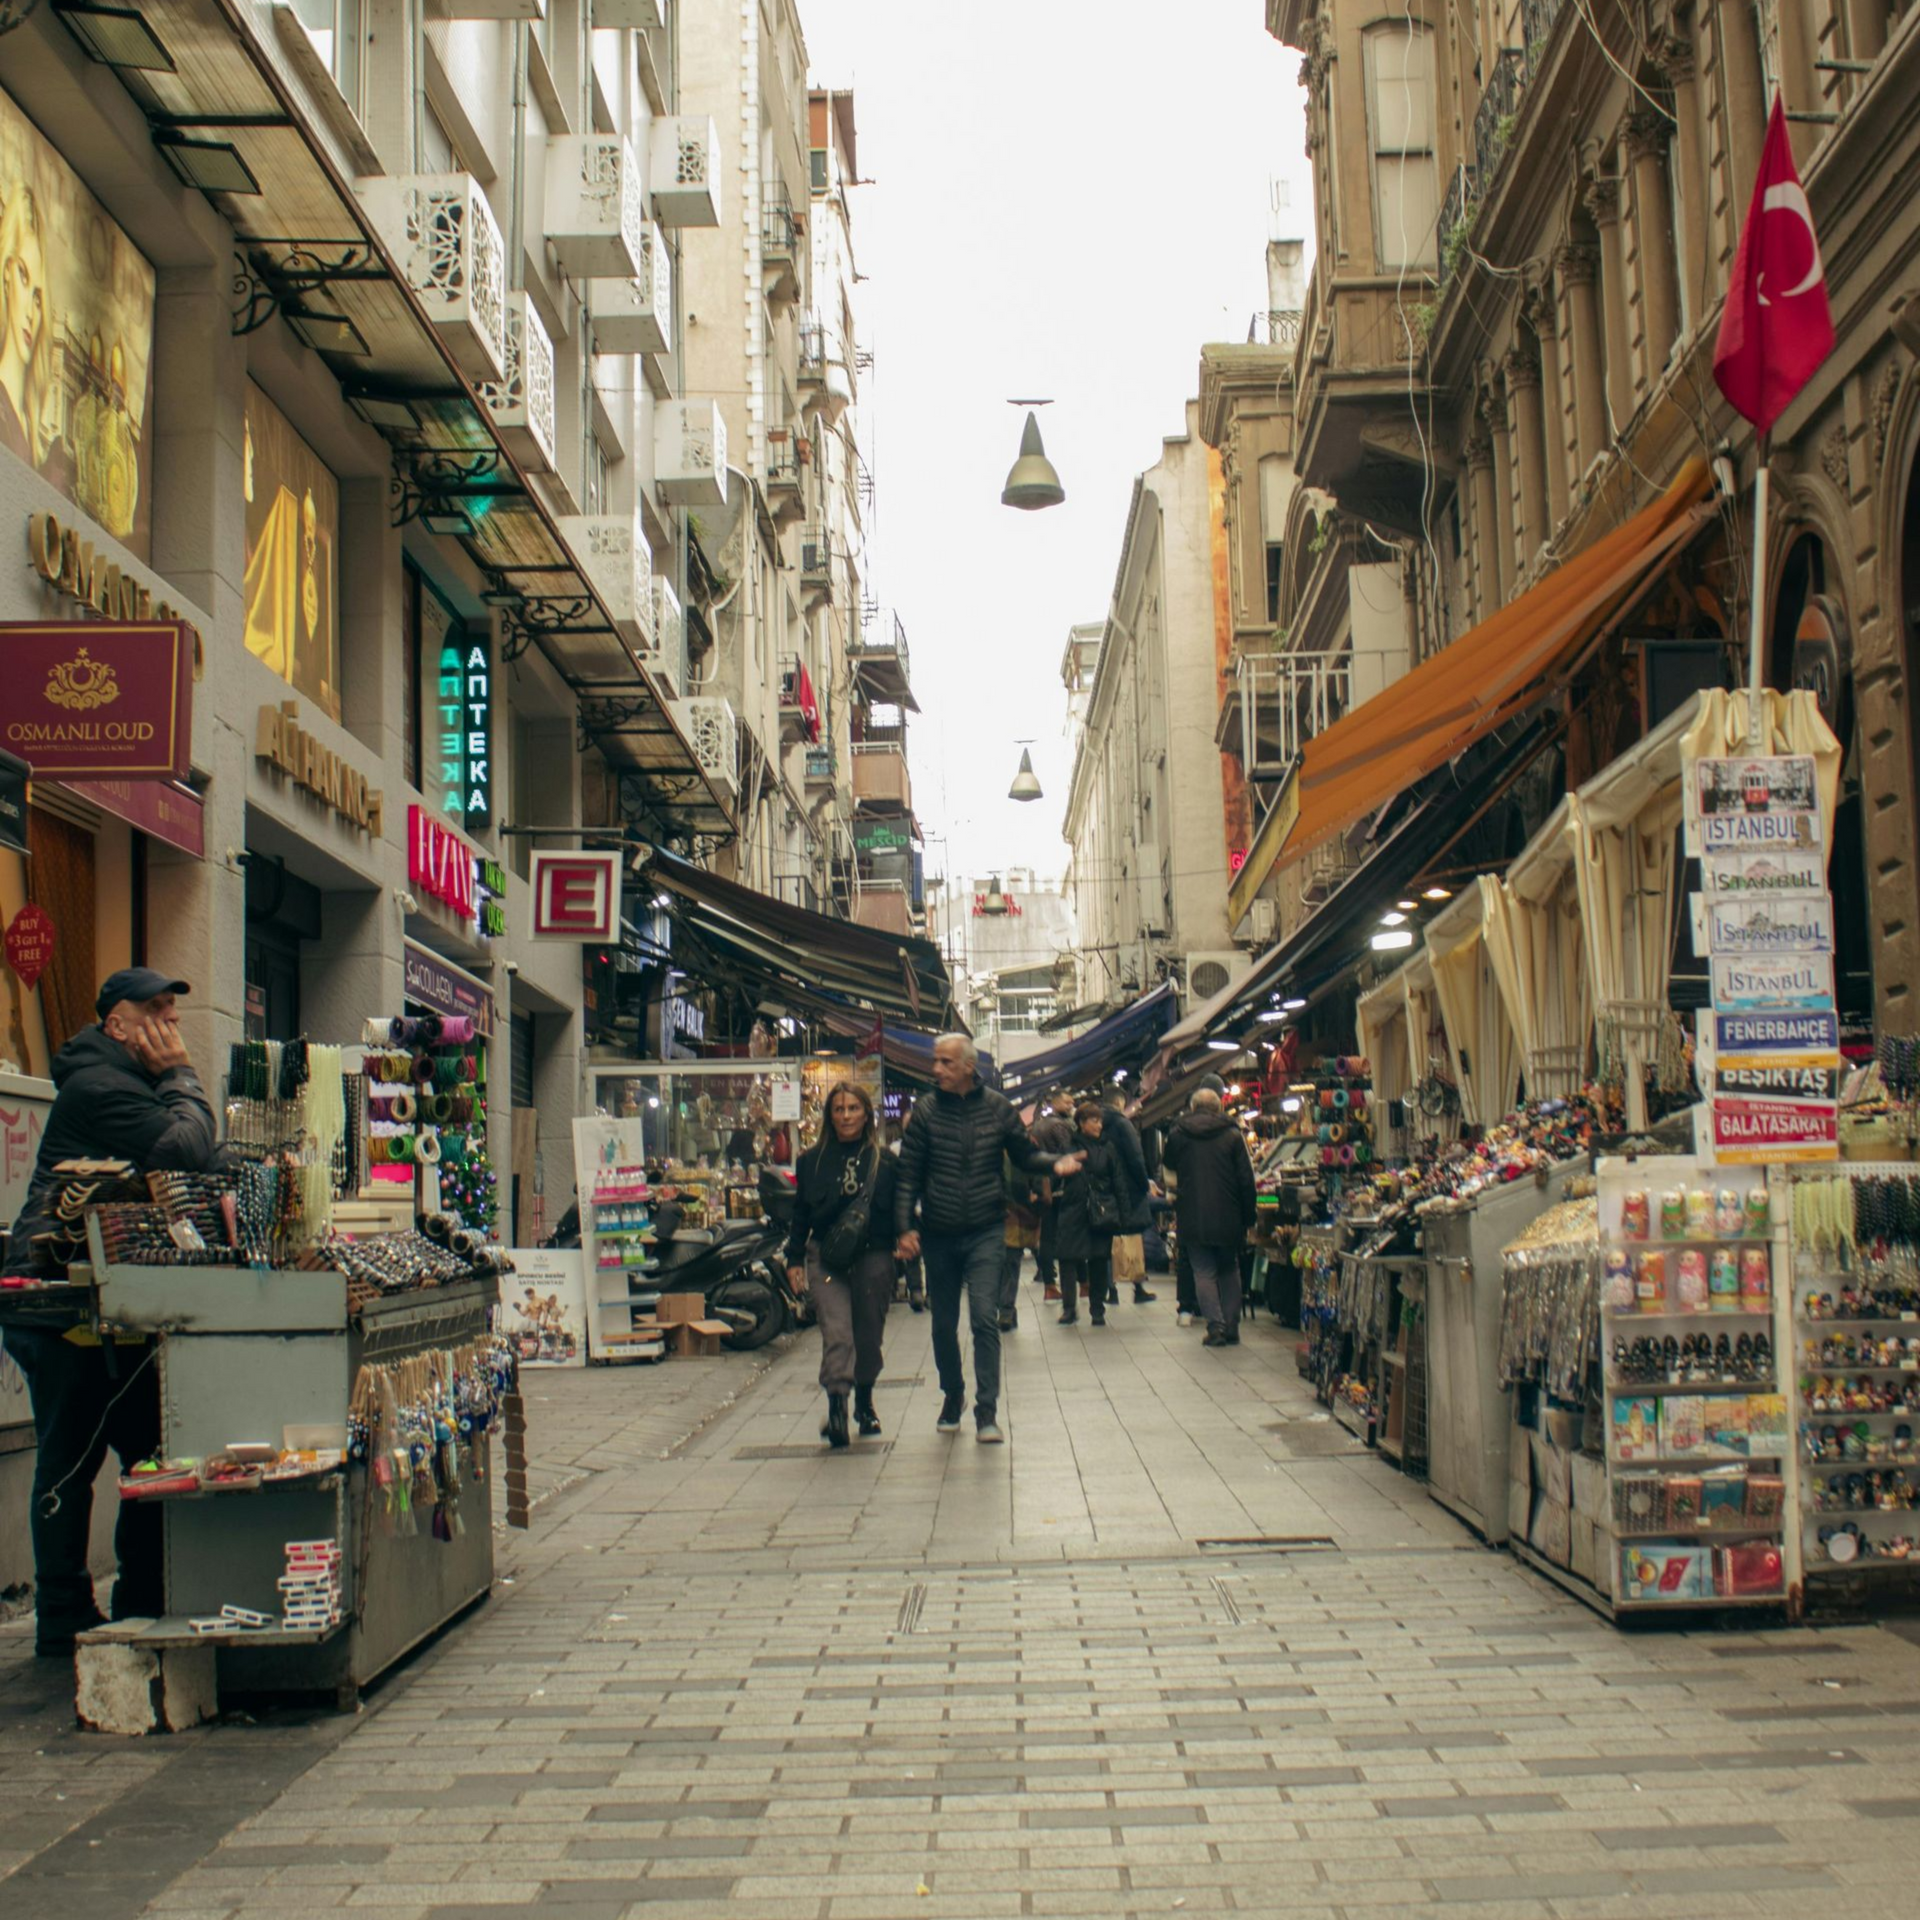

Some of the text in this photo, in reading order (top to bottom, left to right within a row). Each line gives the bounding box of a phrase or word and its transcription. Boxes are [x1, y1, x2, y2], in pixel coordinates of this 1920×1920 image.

[7, 722, 154, 741] OSMANLI OUD
[467, 646, 487, 812] АПТЕКА
[550, 868, 598, 923] E
[19, 918, 40, 931] BUY
[14, 932, 45, 947] 3 GET 1
[18, 948, 42, 962] FREE
[1724, 1019, 1830, 1041] FENERBAHÇE
